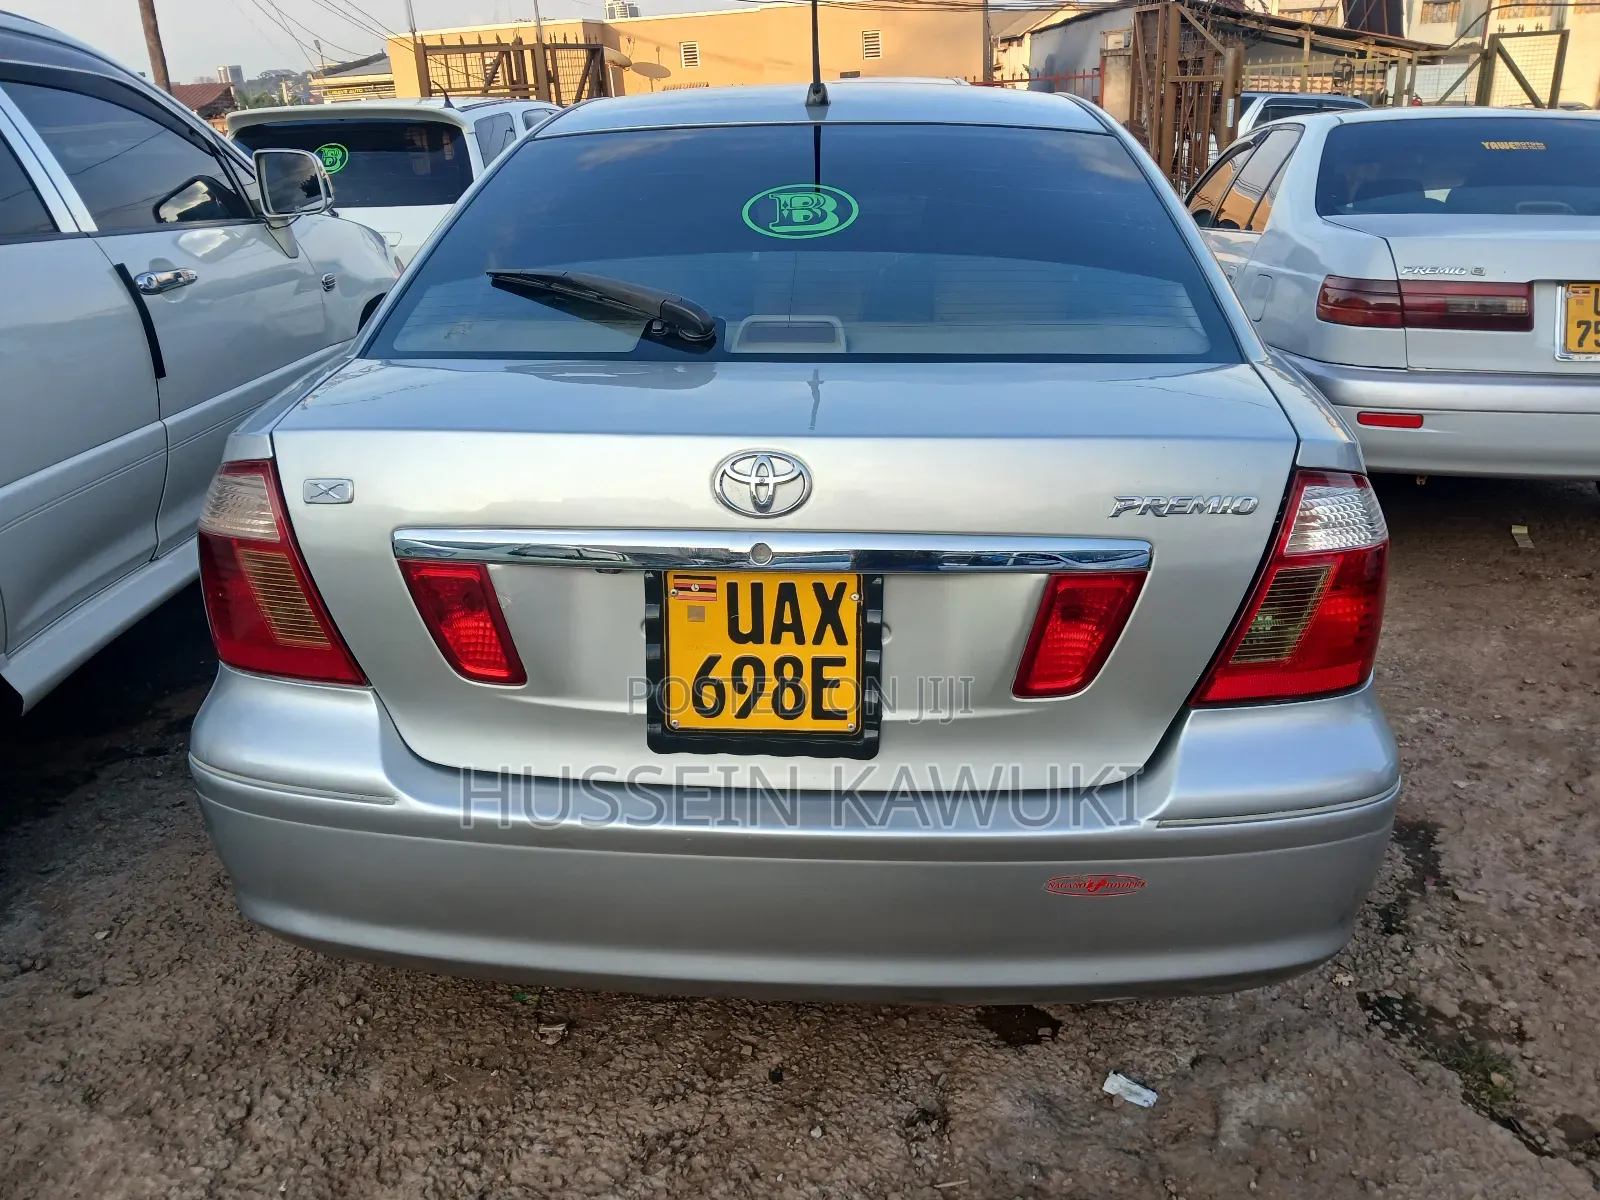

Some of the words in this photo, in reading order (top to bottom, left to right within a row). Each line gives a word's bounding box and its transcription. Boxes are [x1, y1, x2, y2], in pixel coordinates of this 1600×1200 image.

[1481, 142, 1517, 150] YAWE
[769, 192, 839, 232] B
[1401, 266, 1467, 275] PREMIO
[1108, 495, 1260, 518] PREMIO
[726, 581, 849, 646] UAX
[691, 654, 849, 721] 698E
[1048, 881, 1087, 889] NAGANO
